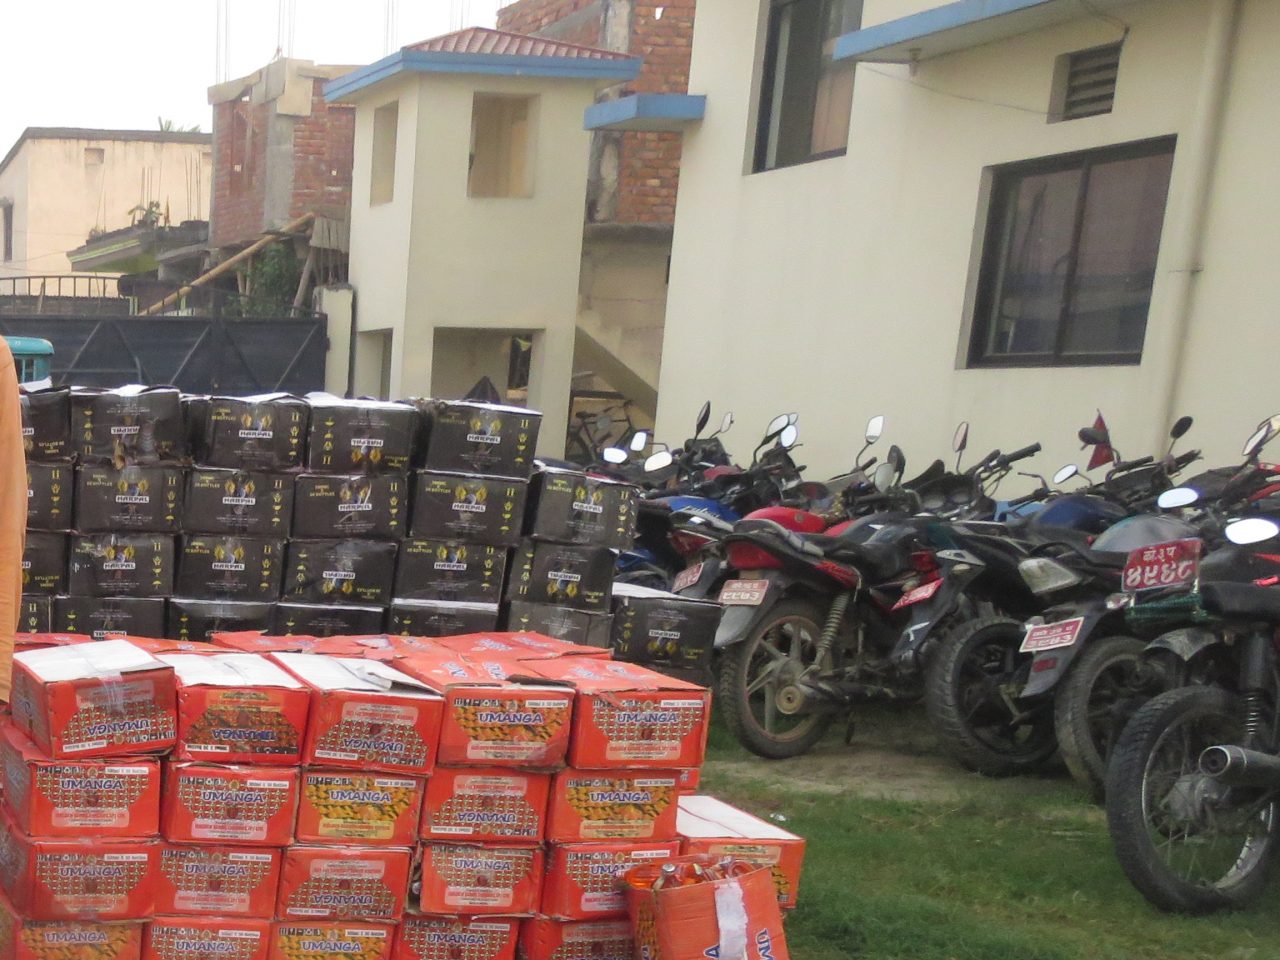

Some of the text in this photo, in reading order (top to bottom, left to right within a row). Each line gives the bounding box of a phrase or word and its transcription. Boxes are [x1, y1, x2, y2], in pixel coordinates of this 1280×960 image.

[478, 712, 544, 725] UMANGA
[616, 711, 678, 724] UMANGA
[87, 719, 150, 736] UMANGA
[343, 738, 405, 755] UMANGA
[60, 778, 123, 790] UMANGA
[202, 789, 264, 803] UMANGA
[330, 789, 391, 803] UMANGA
[589, 791, 651, 803] UMANGA
[457, 811, 518, 823] UMANGA
[59, 865, 122, 877] UMANGA
[184, 863, 247, 876] UMANGA
[453, 859, 511, 872] UMANGA
[313, 894, 374, 905] UMANGA
[45, 931, 108, 943] UMANGA
[427, 932, 487, 945] UMANGA
[175, 939, 236, 952] UMANGA
[301, 940, 361, 952] UMANGA
